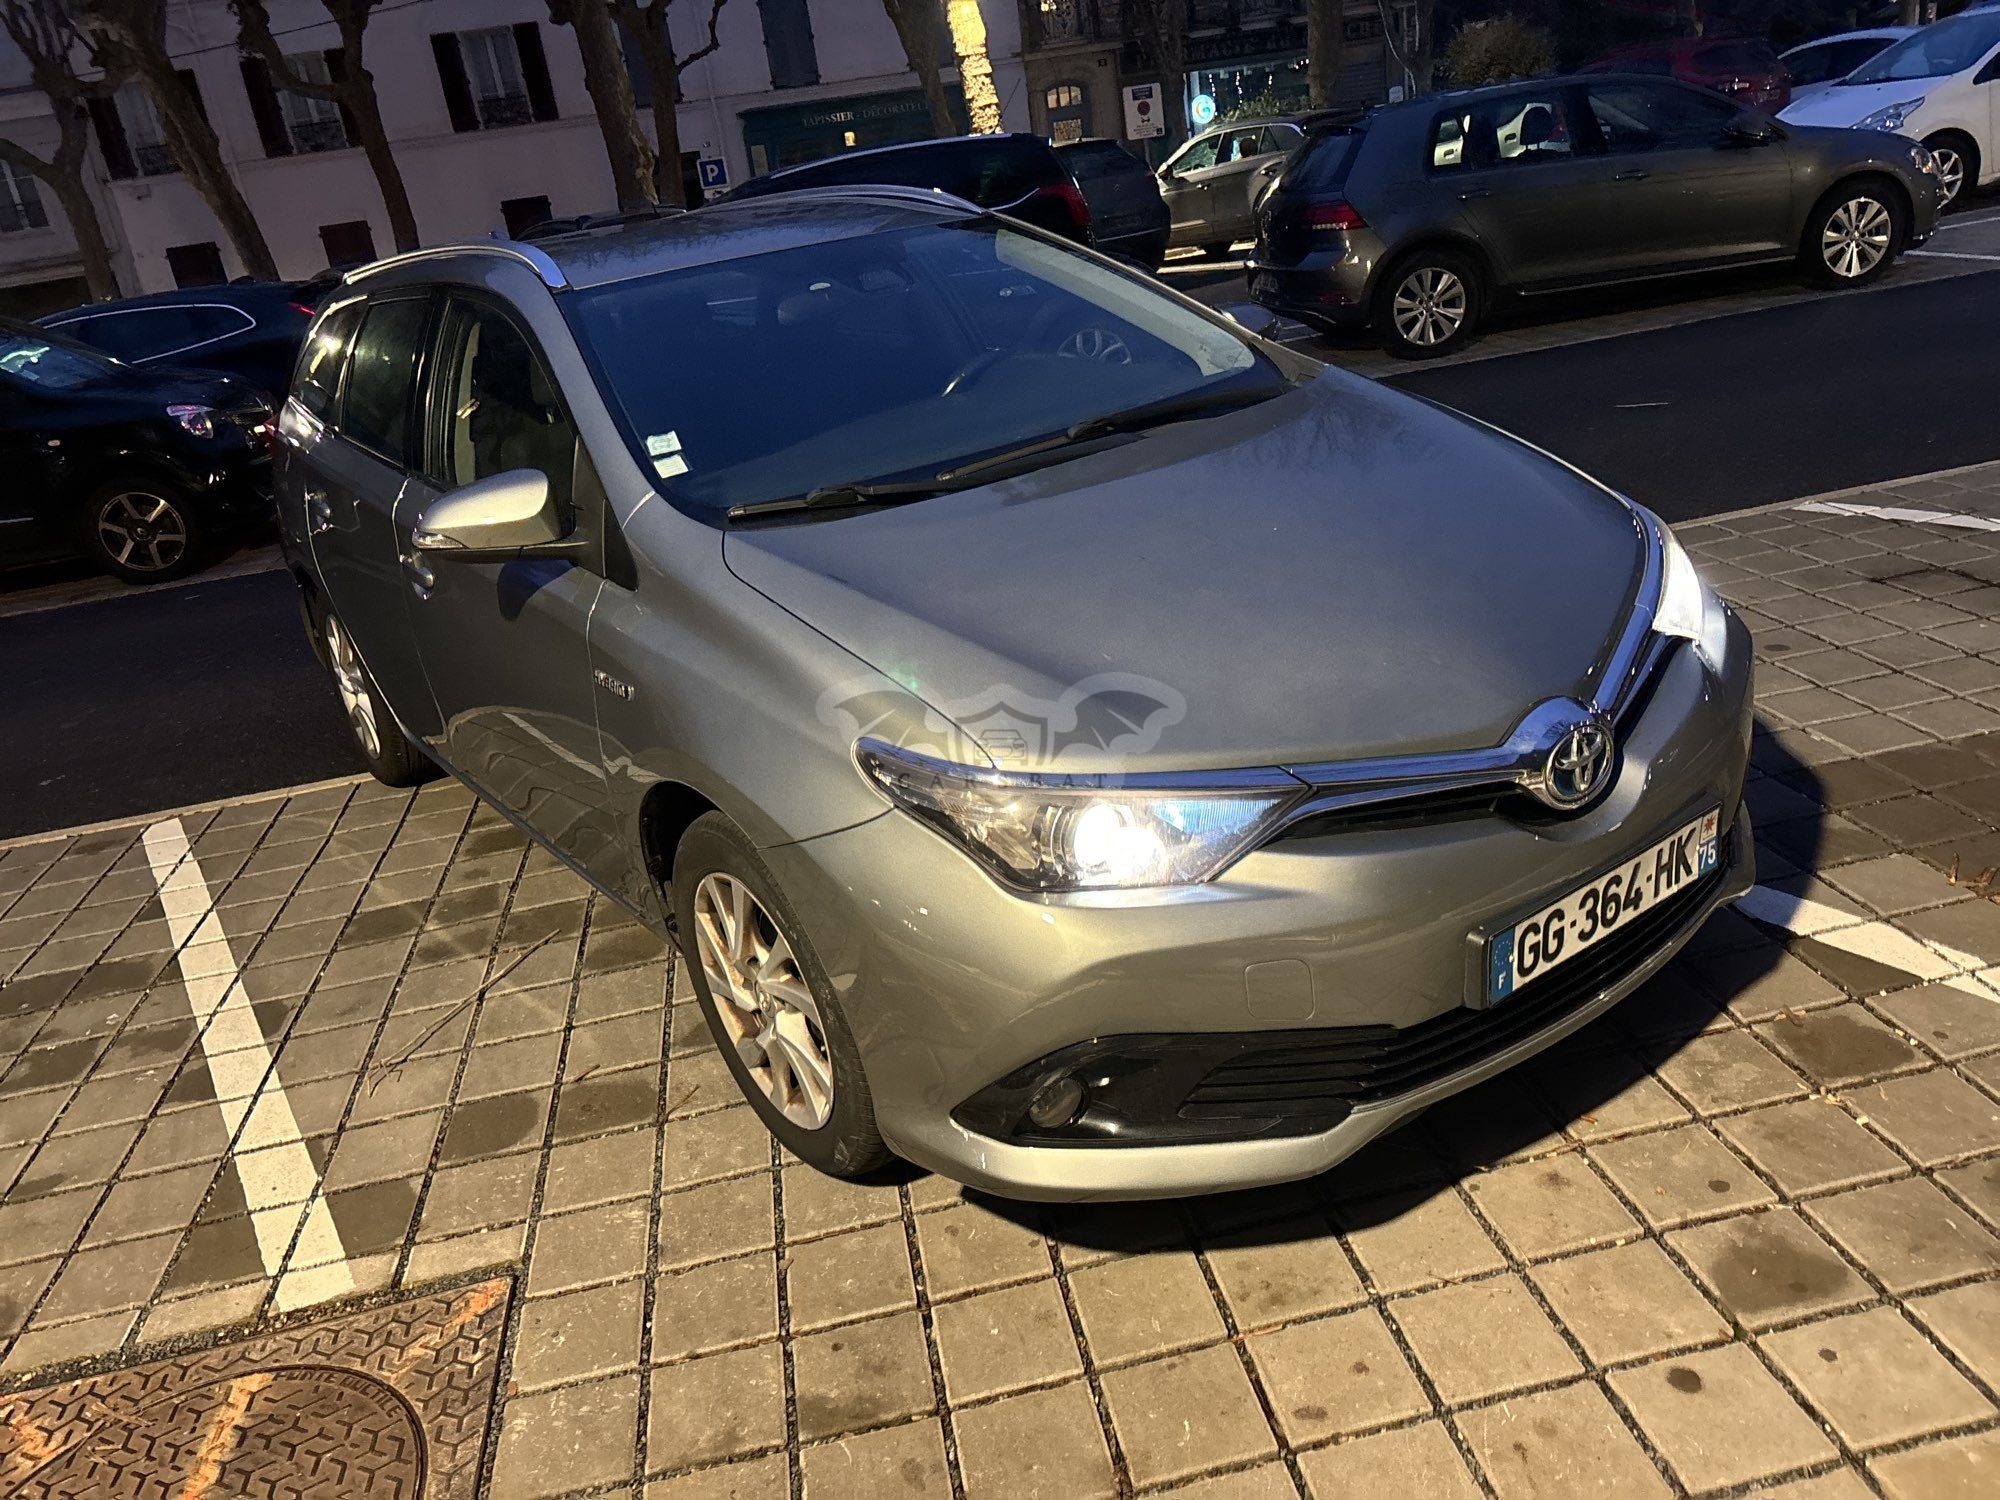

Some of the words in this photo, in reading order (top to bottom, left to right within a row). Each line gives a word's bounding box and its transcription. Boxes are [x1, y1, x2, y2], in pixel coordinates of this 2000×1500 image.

[803, 111, 854, 127] TAPISSIER
[706, 164, 719, 182] P
[1498, 973, 1506, 989] F
[1517, 827, 1696, 978] GG-364-HK
[1700, 840, 1716, 870] 75
[339, 1375, 401, 1419] DUCTILE
